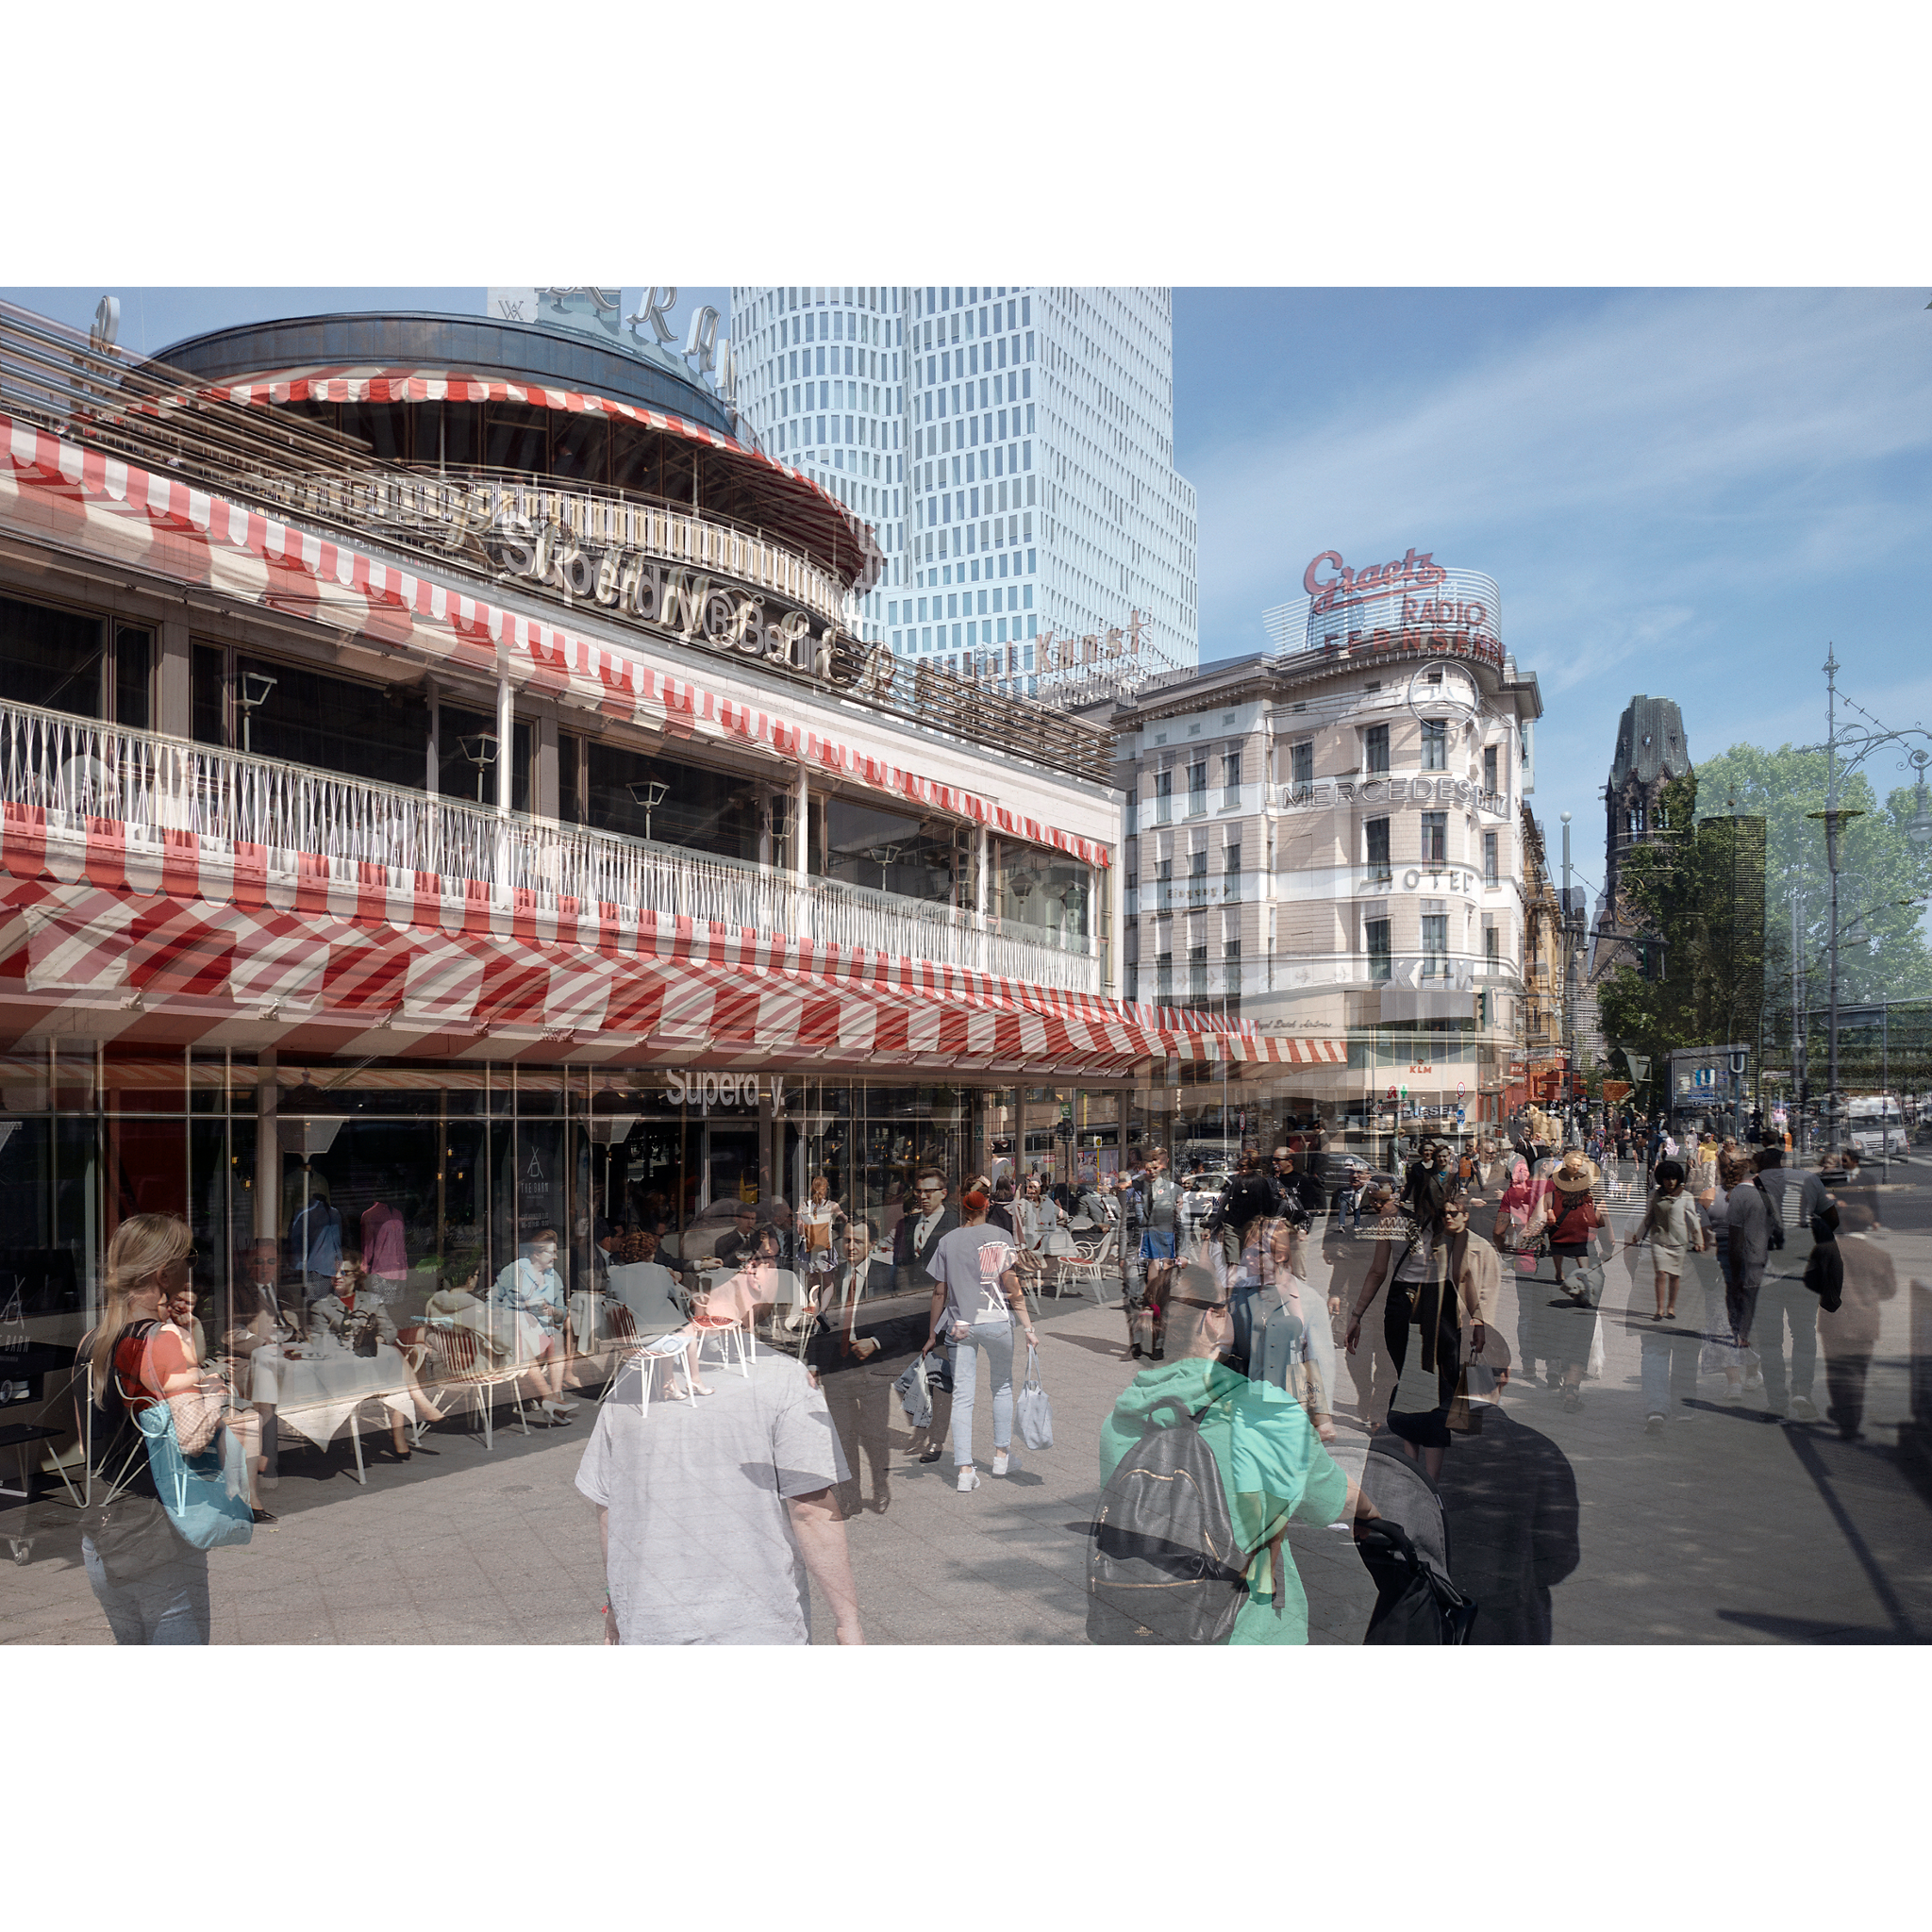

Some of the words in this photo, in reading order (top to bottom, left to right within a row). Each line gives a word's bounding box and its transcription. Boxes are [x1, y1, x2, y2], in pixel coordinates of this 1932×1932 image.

[1304, 547, 1447, 615] Graetz
[1403, 597, 1487, 626] RADIO
[1036, 610, 1142, 675] Kunst
[1283, 777, 1472, 808] MERCEDES
[1167, 886, 1218, 900] Eingang
[1377, 868, 1470, 892] HOTEL
[5, 1335, 31, 1353] BARN
